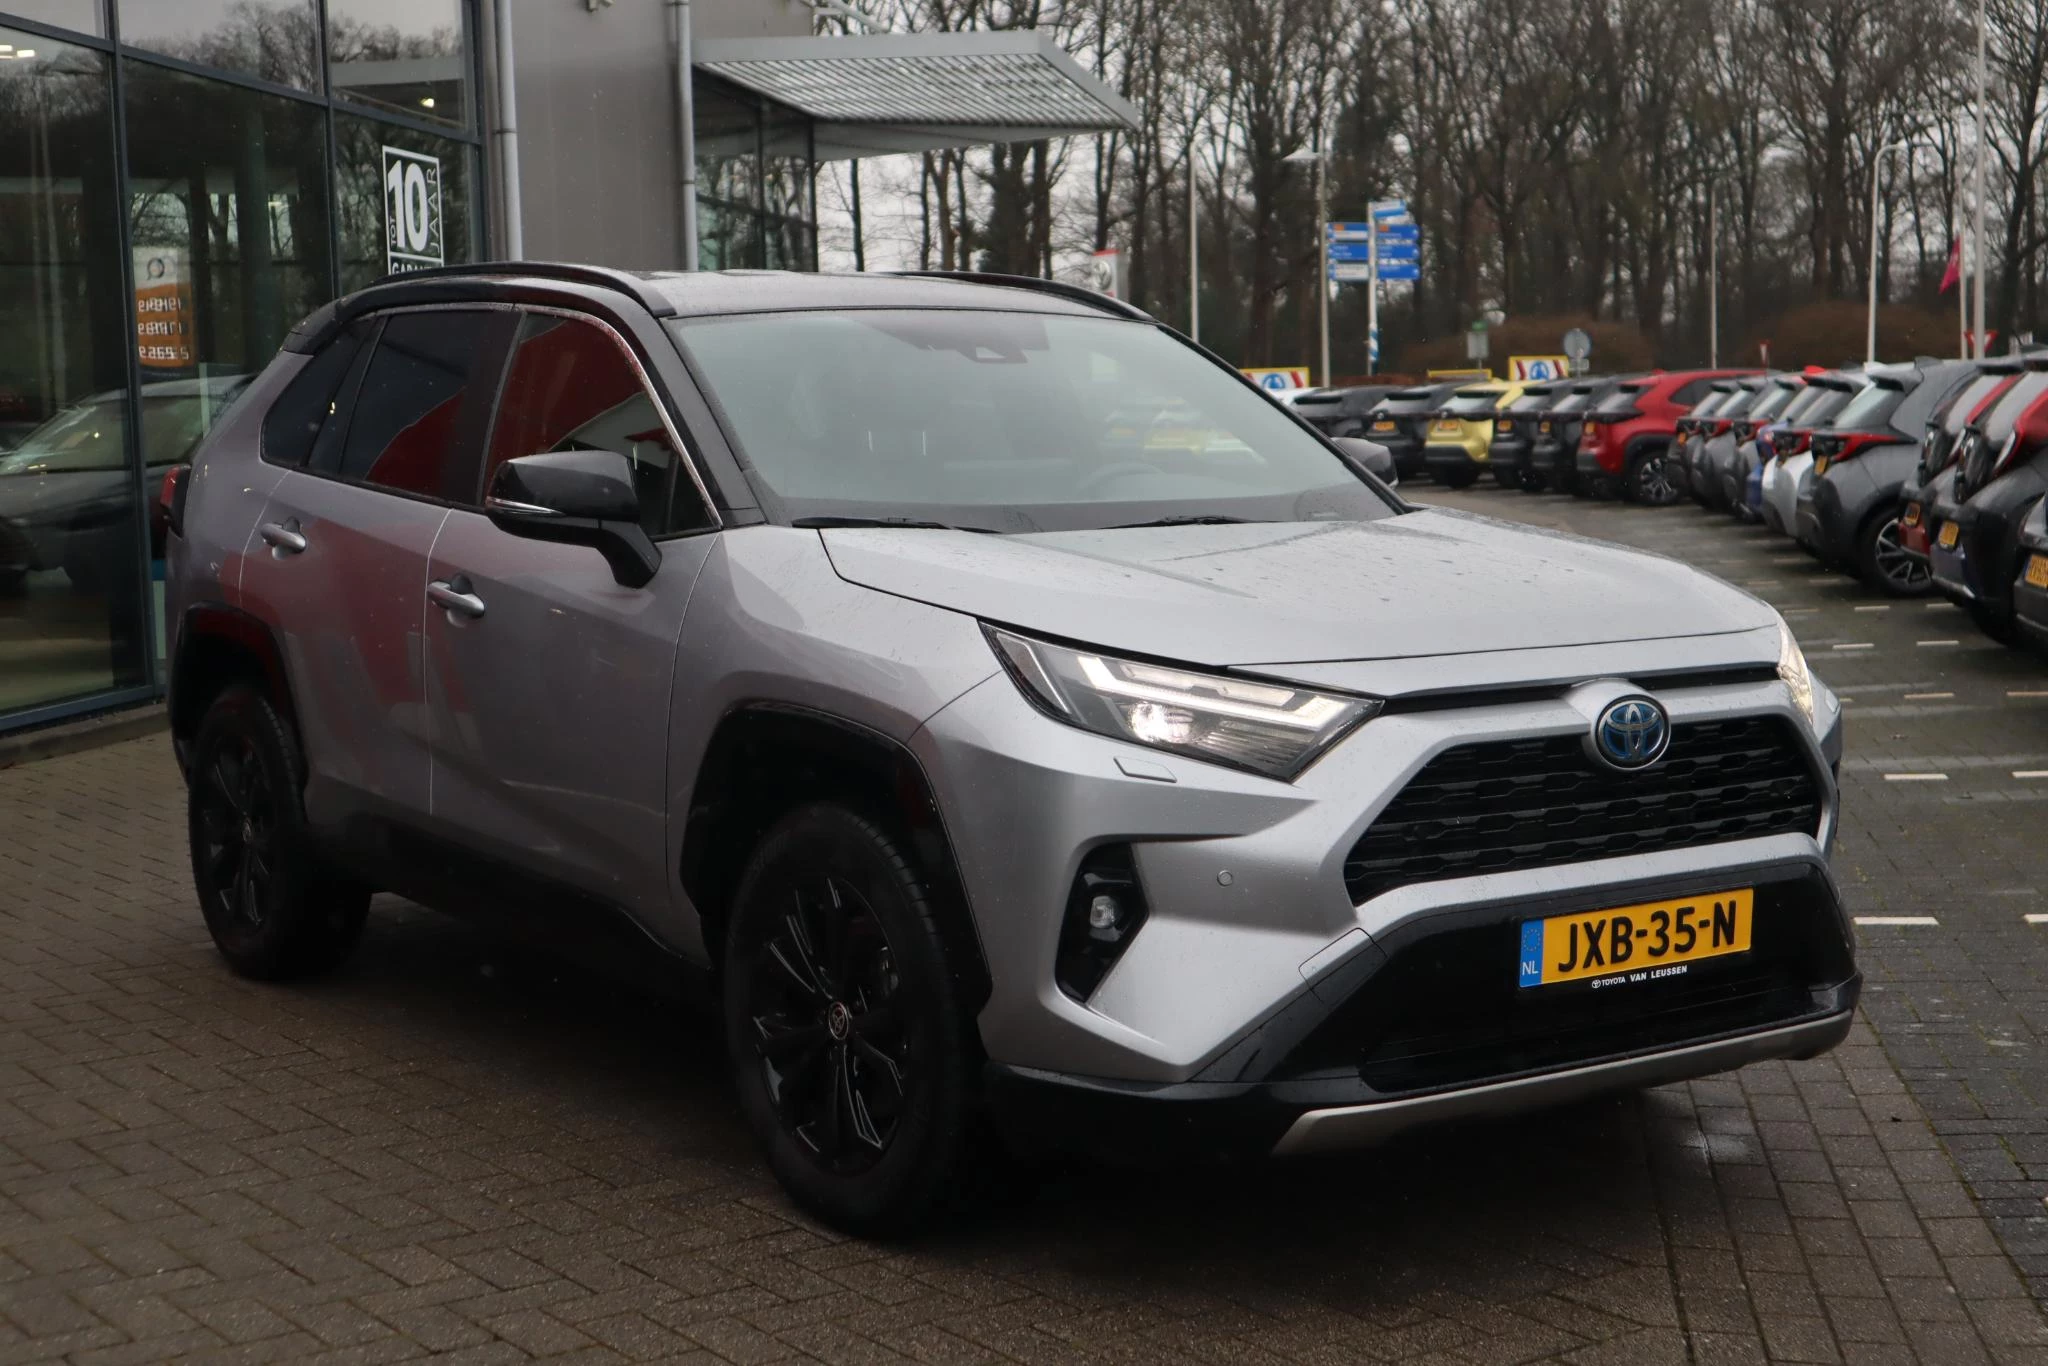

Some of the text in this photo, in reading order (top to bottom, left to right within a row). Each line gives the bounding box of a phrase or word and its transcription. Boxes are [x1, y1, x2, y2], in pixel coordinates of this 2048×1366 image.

[387, 159, 428, 252] 10
[389, 215, 397, 247] TOT
[426, 167, 440, 254] JAAR
[1557, 900, 1737, 973] JXB-35-N
[1521, 960, 1539, 976] NL
[1601, 965, 1688, 987] TOYOTA VAN LEUSSEN
